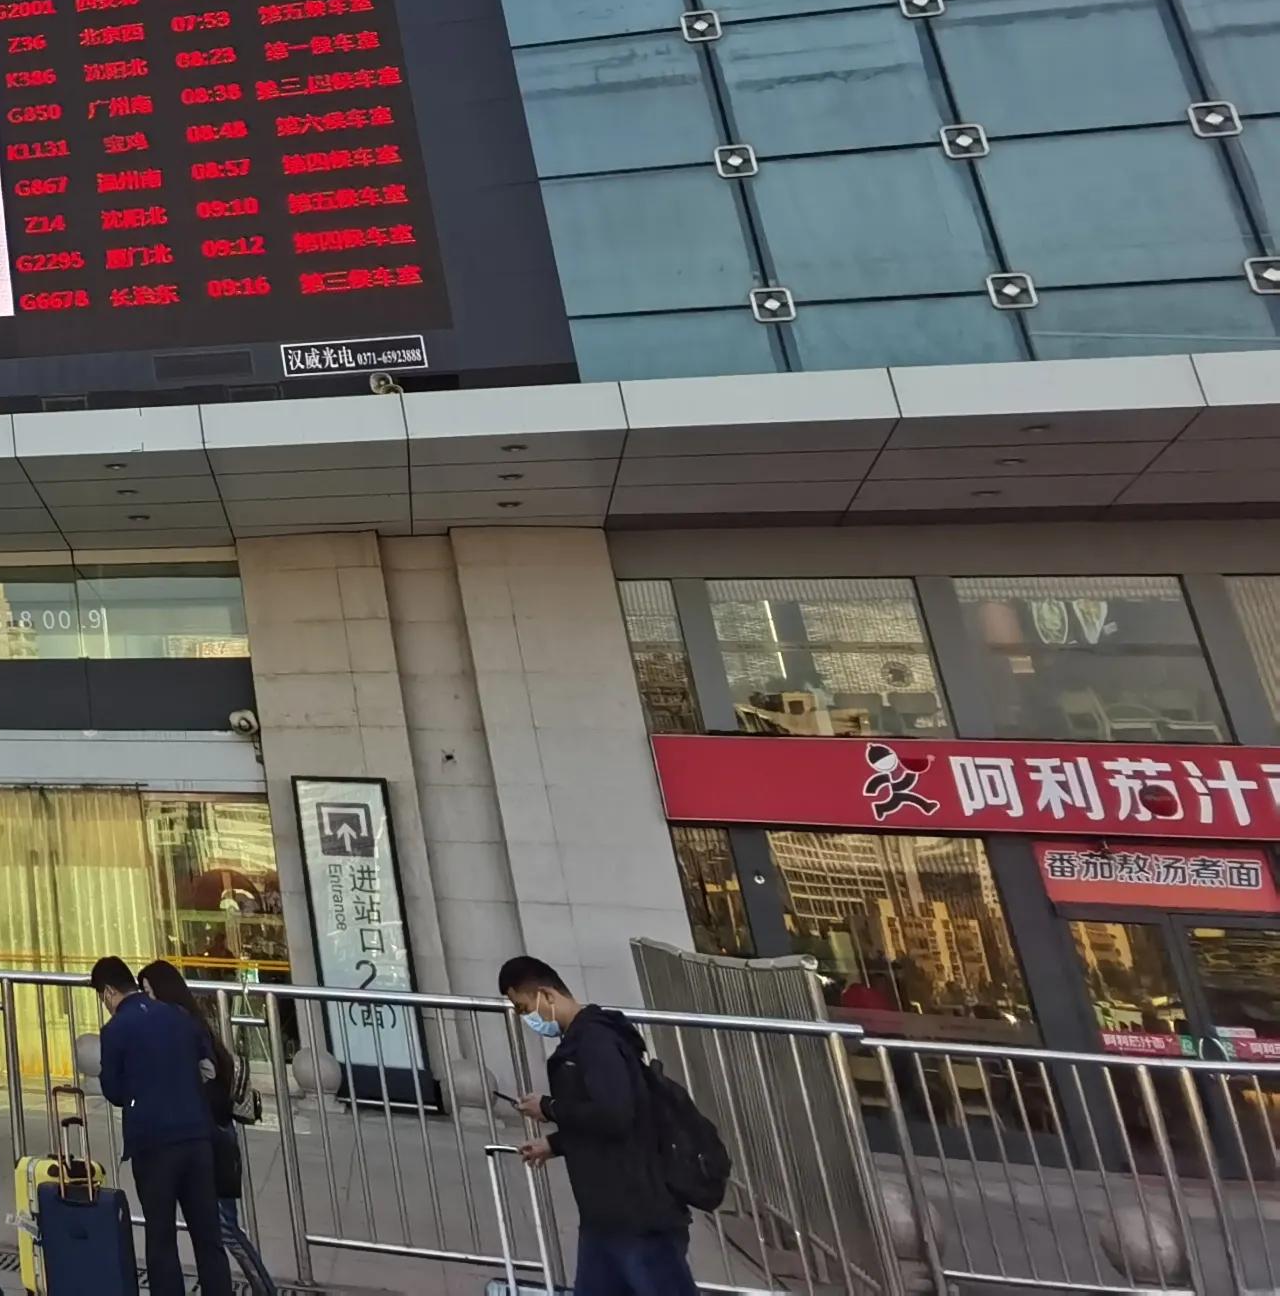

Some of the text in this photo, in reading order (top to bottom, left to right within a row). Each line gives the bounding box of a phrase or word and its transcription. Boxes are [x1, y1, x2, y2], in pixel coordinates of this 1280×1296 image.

[24, 214, 67, 235] Z14
[288, 346, 356, 371] 汉威光电
[947, 755, 1280, 827] 阿利茄汁
[1044, 850, 1263, 891] 番茄熬汤煮面
[328, 863, 348, 932] Entrance
[349, 864, 386, 954] 进站口
[355, 959, 378, 991] 2
